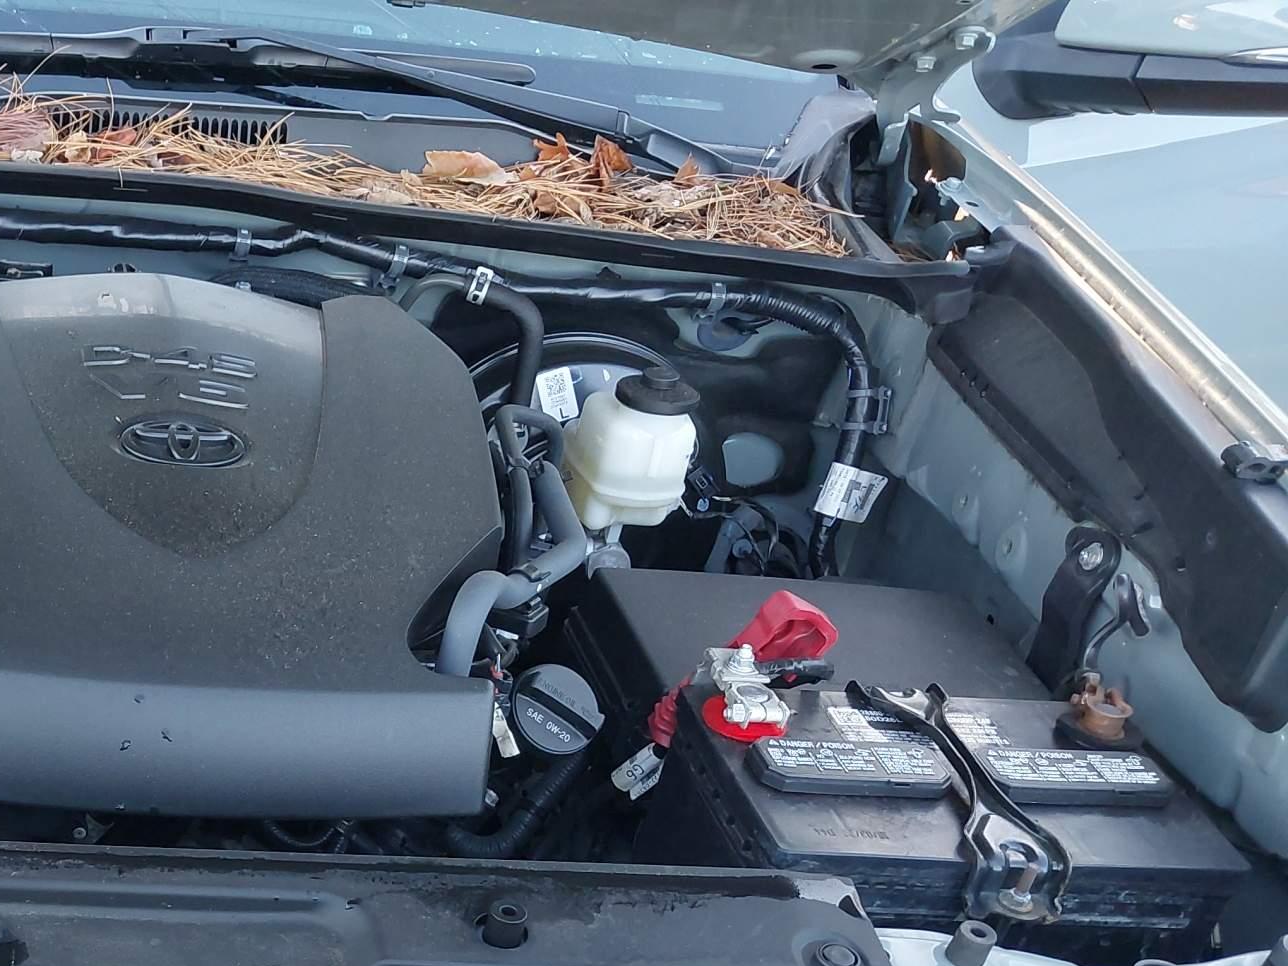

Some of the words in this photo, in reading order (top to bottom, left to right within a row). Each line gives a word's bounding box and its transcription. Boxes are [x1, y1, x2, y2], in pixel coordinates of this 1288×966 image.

[559, 407, 570, 419] L
[526, 707, 545, 724] SAE
[545, 720, 571, 743] 0W-20
[778, 739, 814, 748] DANGER
[821, 742, 856, 750] POISON
[997, 750, 1034, 758] DANGER
[626, 763, 645, 780] G6
